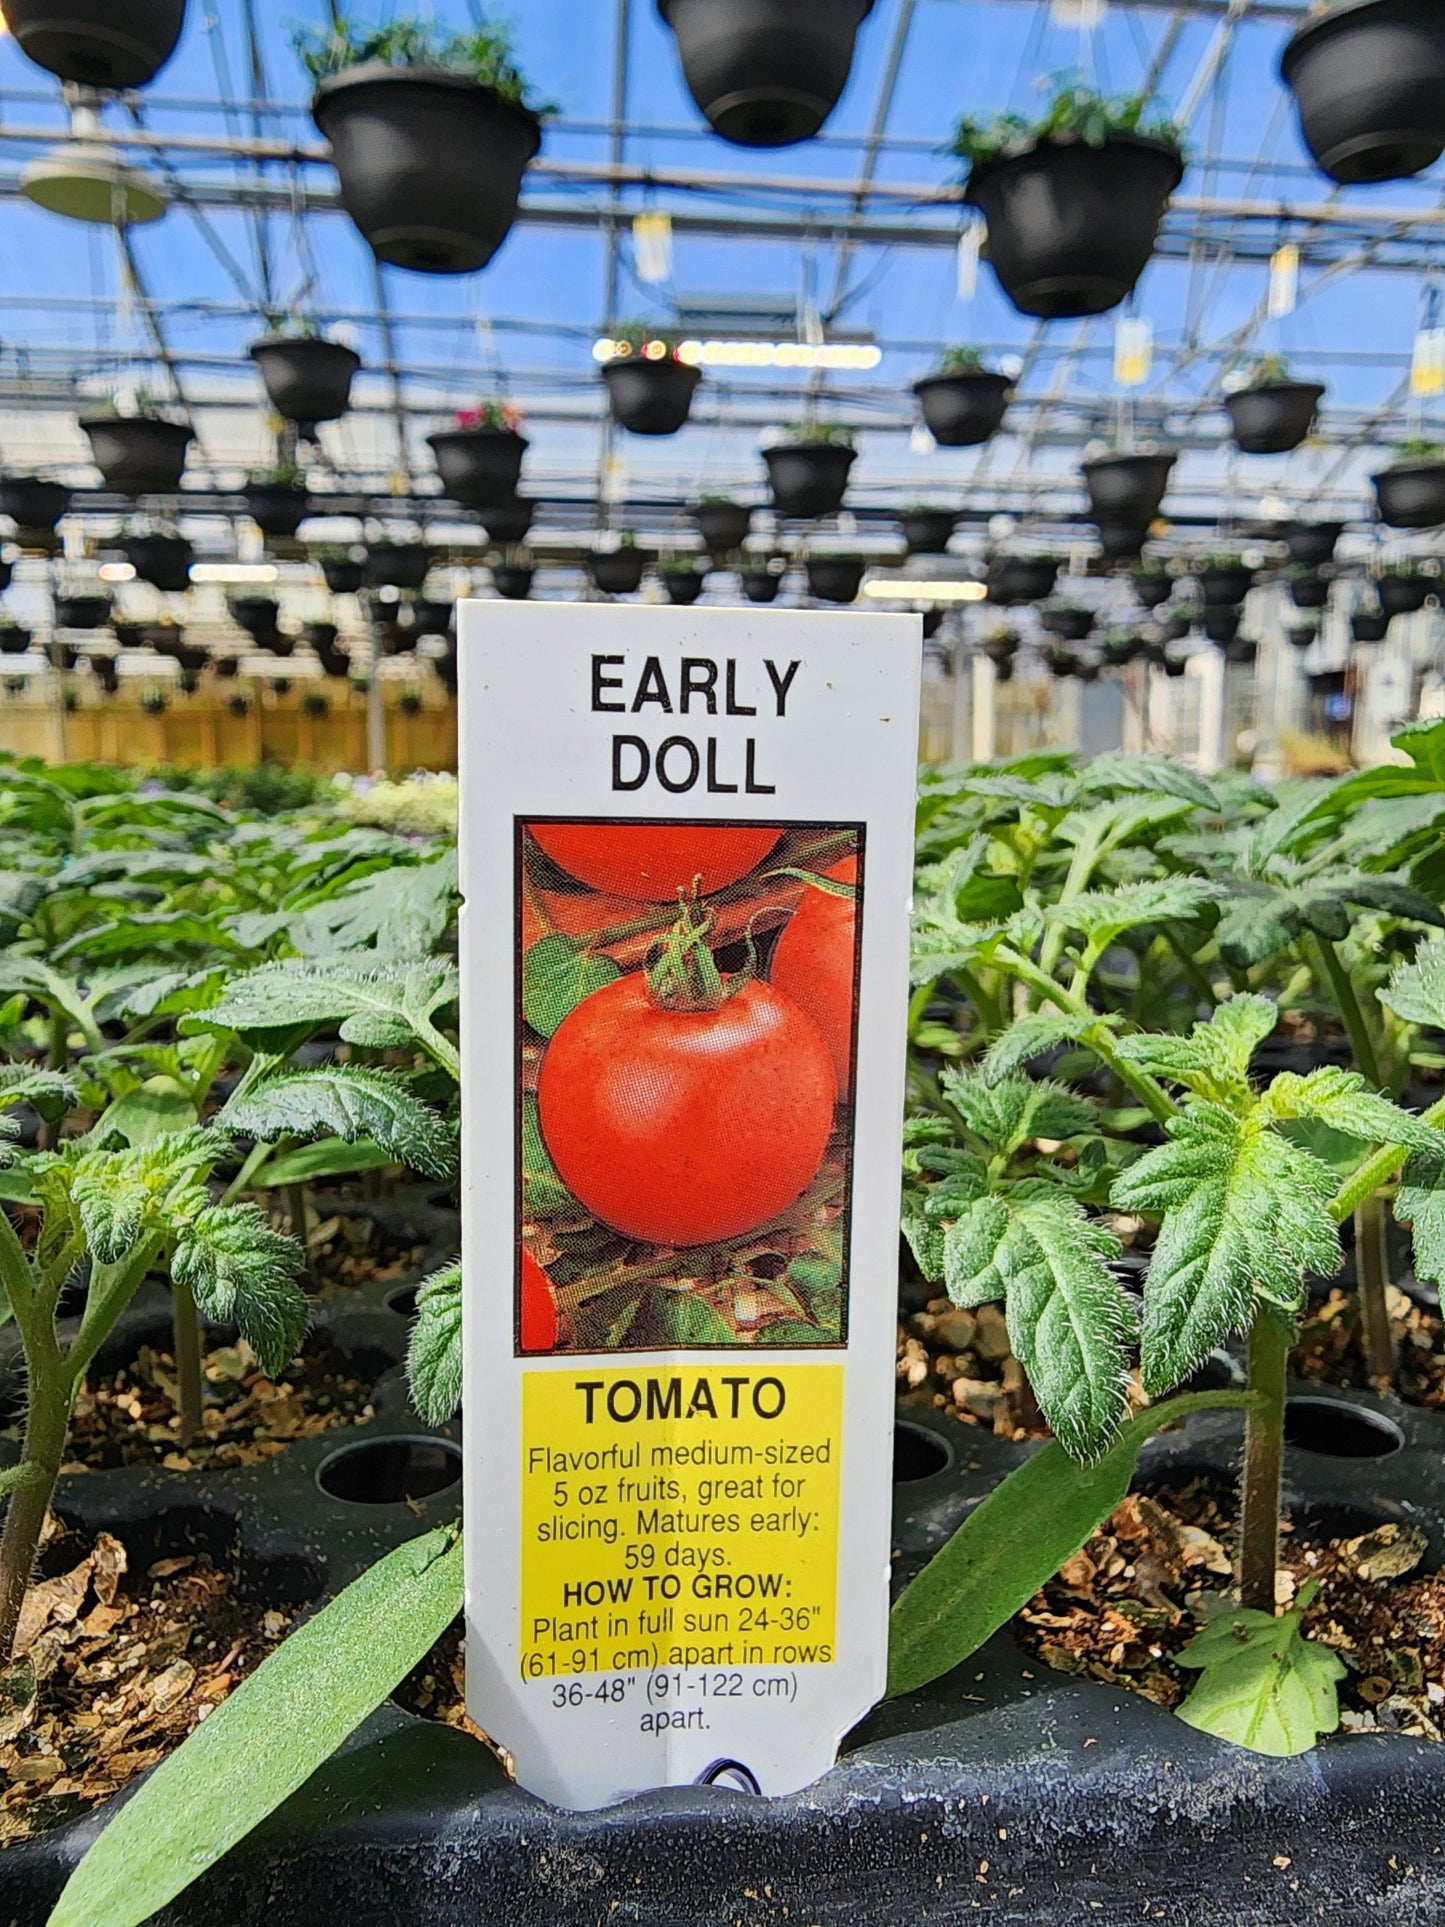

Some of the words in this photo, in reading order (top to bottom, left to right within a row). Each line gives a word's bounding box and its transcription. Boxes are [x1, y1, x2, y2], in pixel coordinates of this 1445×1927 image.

[591, 653, 801, 717] EARLY
[612, 734, 776, 794] DOLL
[575, 1377, 786, 1424] TOMATO
[528, 1441, 640, 1473] Flavorful
[651, 1438, 831, 1466] medium-sized
[554, 1481, 568, 1506] 5
[578, 1486, 608, 1505] oz
[617, 1477, 687, 1503] fruits,
[698, 1477, 763, 1505] great
[772, 1473, 805, 1498] for
[537, 1515, 625, 1544] slicing.
[637, 1509, 740, 1535] Matures
[750, 1507, 819, 1537] early:
[624, 1543, 655, 1570] 59
[665, 1541, 732, 1572] days.
[563, 1577, 633, 1607] HOW
[642, 1574, 681, 1600] TO
[692, 1573, 792, 1599] GROW:
[533, 1615, 598, 1643] Plant
[608, 1612, 628, 1637] in
[639, 1608, 673, 1634] full
[684, 1613, 728, 1632] sun
[739, 1606, 821, 1632] 24-36"
[520, 1648, 598, 1684] (61-91
[613, 1642, 659, 1673] cm)
[669, 1642, 733, 1670] apart
[743, 1641, 763, 1664] in
[774, 1644, 832, 1663] rows
[552, 1677, 635, 1708] 36-48"
[647, 1673, 743, 1705] (91-122
[752, 1671, 798, 1702] cm)
[640, 1707, 711, 1737] apart.
